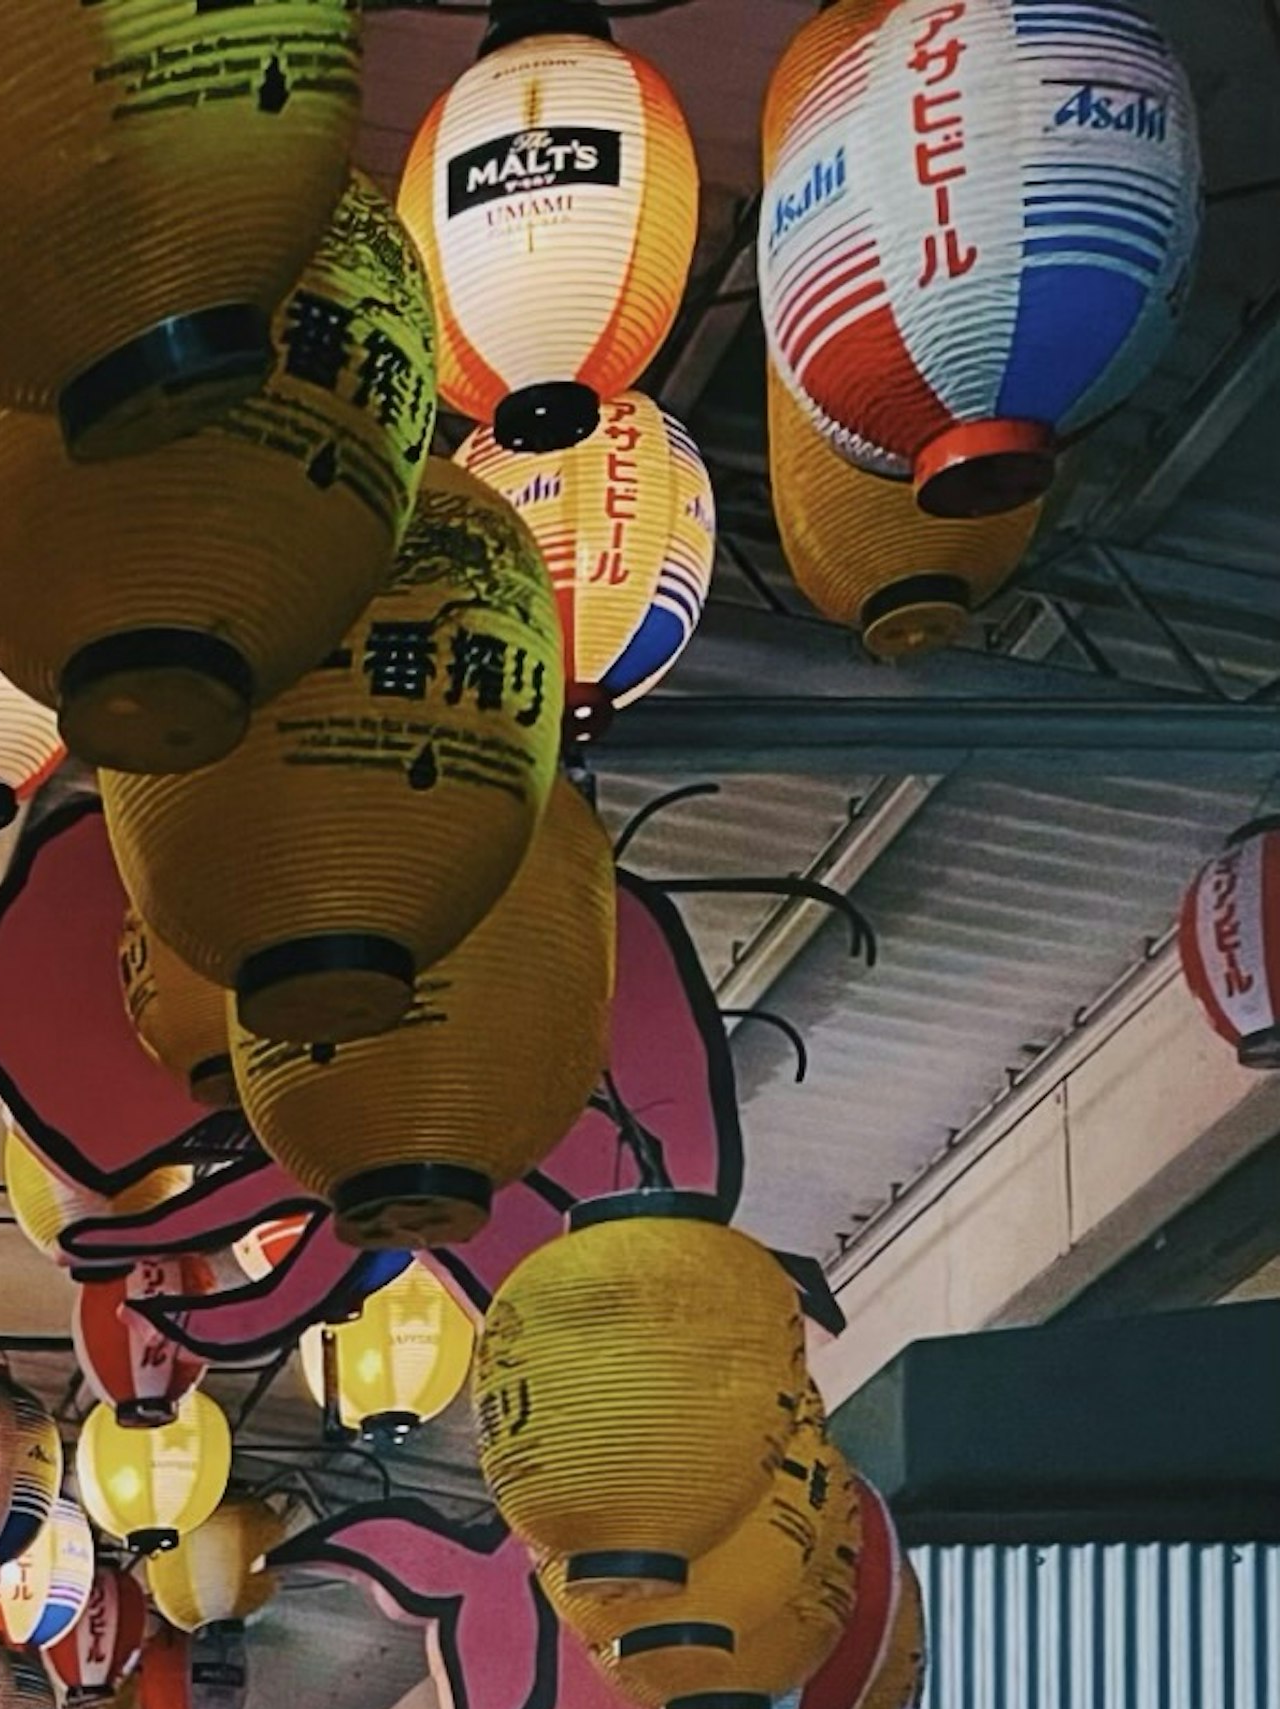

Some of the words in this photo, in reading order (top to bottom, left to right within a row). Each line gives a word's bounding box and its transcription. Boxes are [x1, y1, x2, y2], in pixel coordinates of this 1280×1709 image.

[1052, 83, 1168, 144] Asahi
[467, 139, 598, 193] MALT'S
[768, 146, 848, 248] Asahi
[590, 402, 641, 587] アサヒビール
